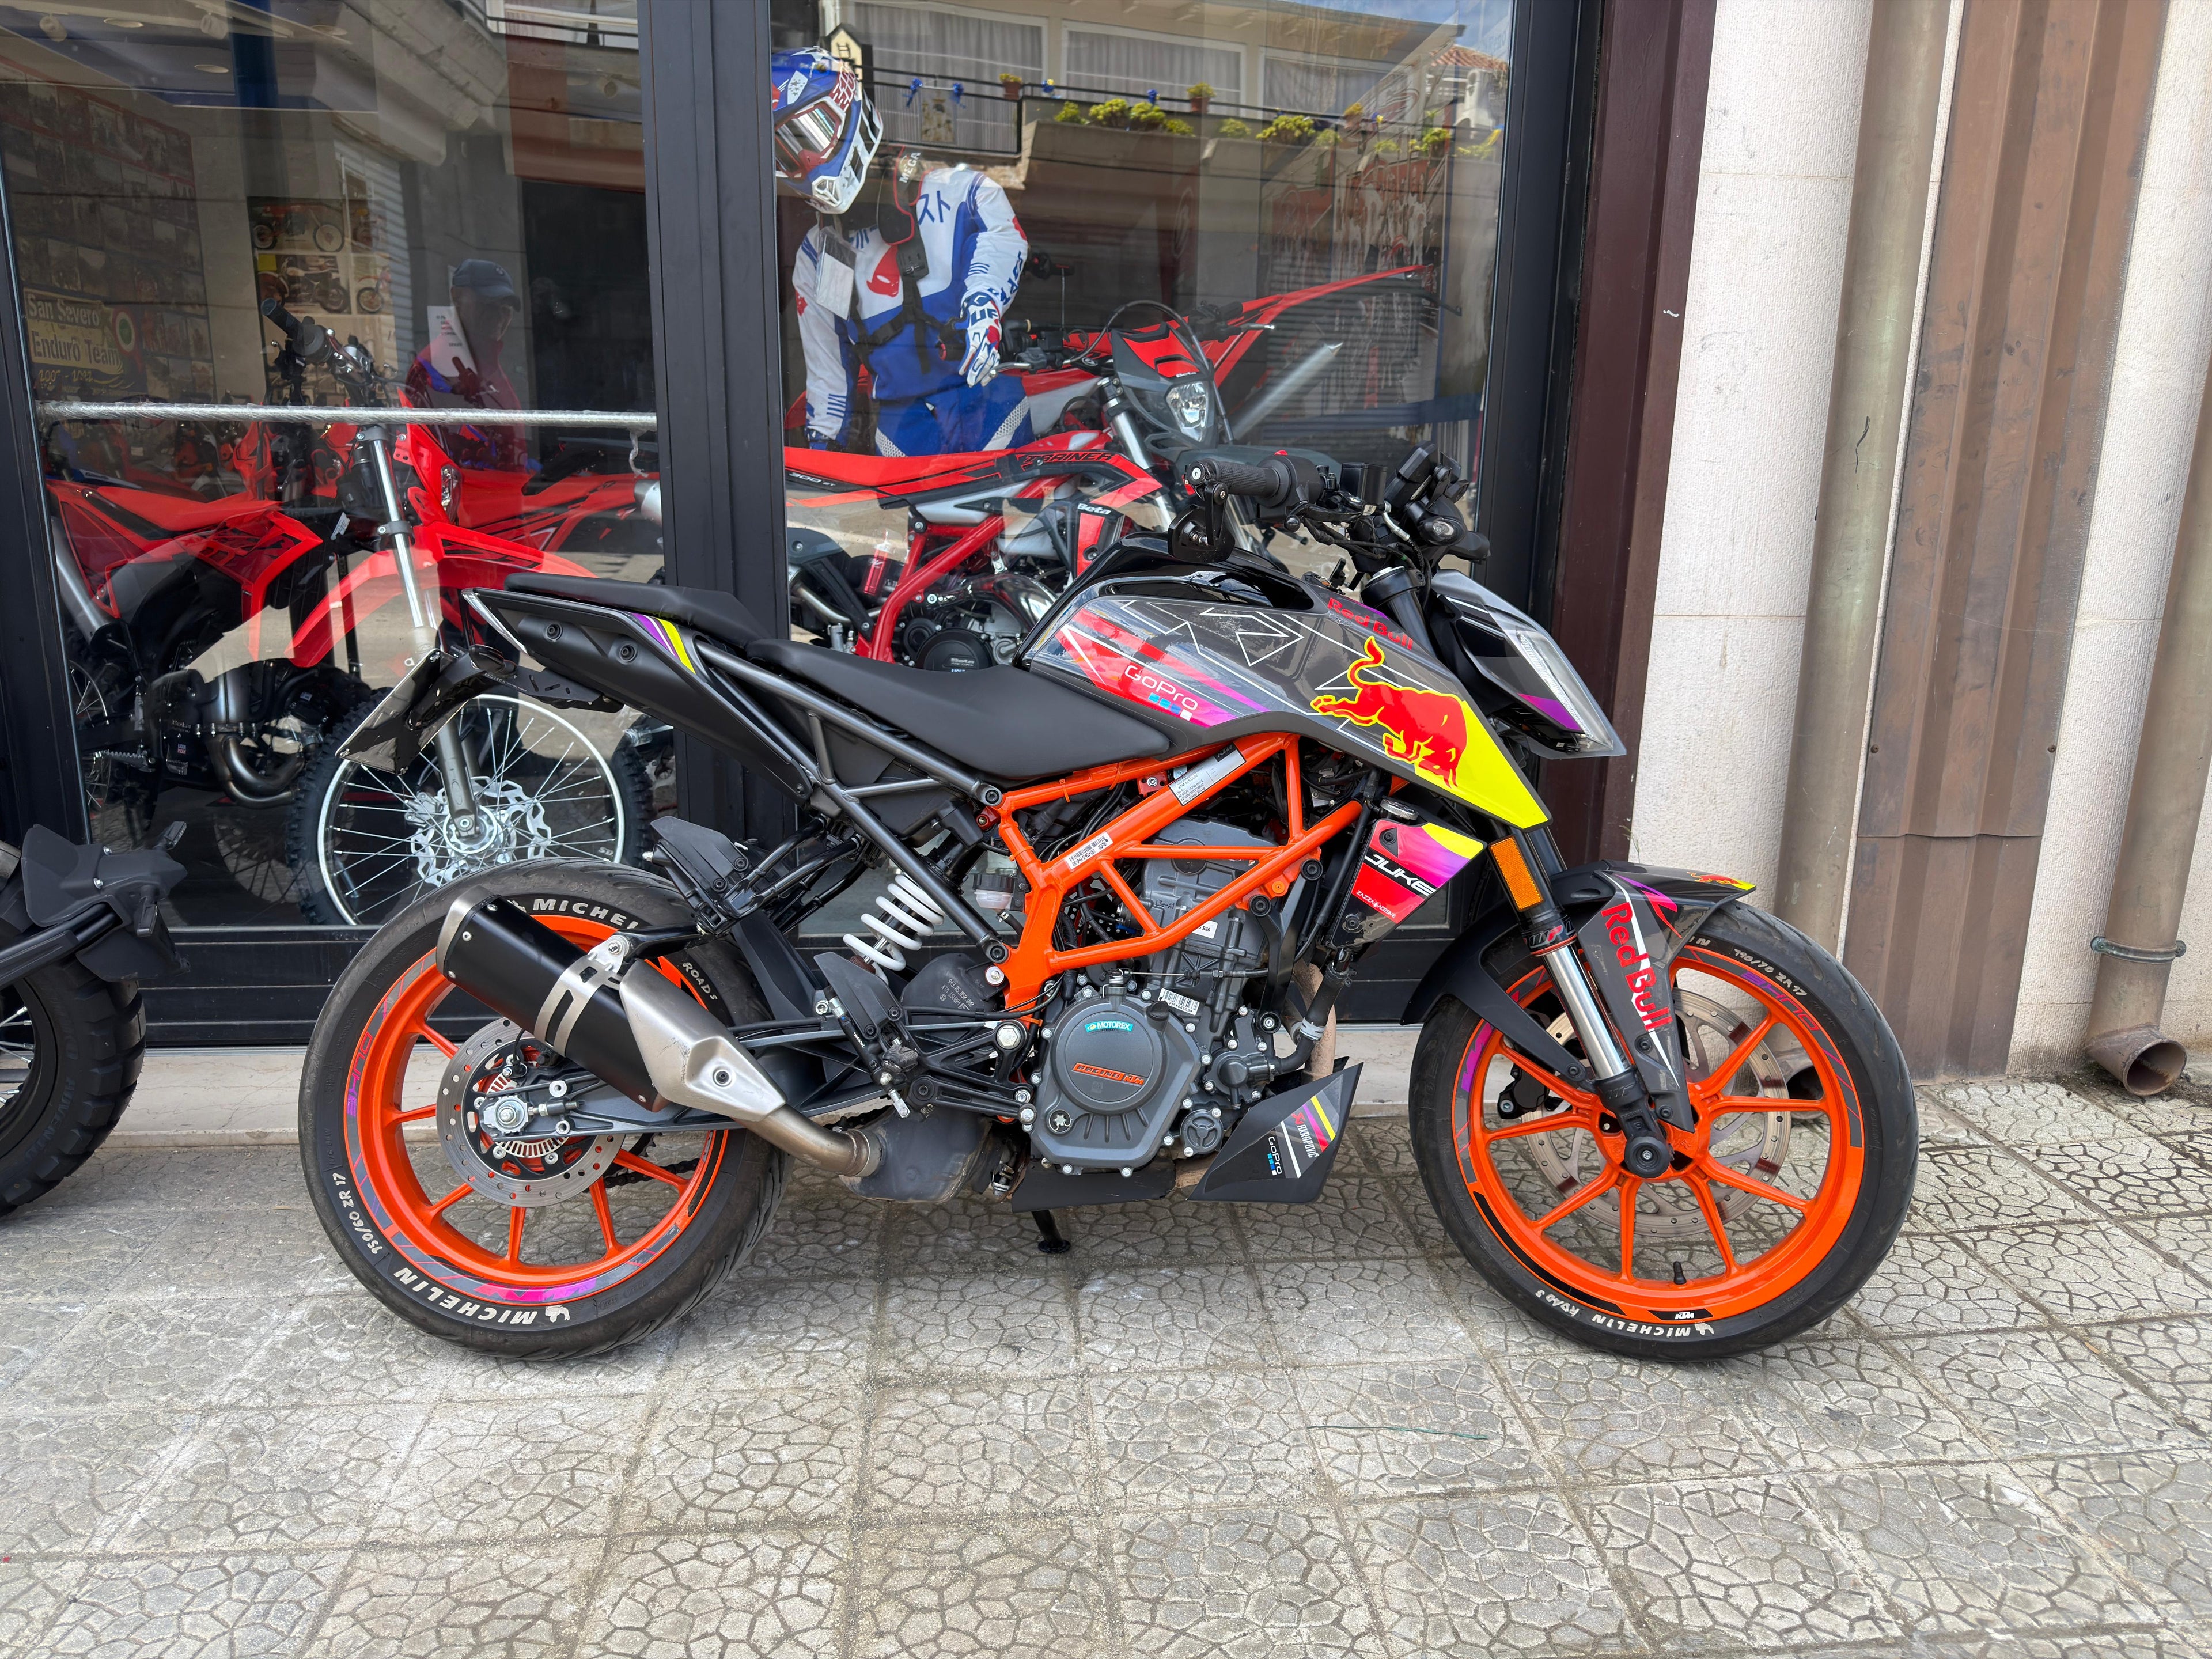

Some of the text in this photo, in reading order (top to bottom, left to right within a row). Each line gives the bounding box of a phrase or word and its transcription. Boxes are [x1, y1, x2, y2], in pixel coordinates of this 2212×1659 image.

[899, 152, 921, 183] MEGA
[28, 294, 100, 326] San Severo
[32, 330, 119, 366] Enduro Team
[789, 472, 822, 483] 300
[1078, 503, 1111, 515] Beta
[1328, 597, 1414, 650] Red Bull
[484, 672, 506, 684] EVOTECH
[1124, 665, 1199, 711] GoPro
[1364, 854, 1437, 896] DUKE
[683, 961, 711, 994] ROAD
[1601, 902, 1673, 1031] Red Bull
[1097, 1021, 1130, 1030] MOTOREX
[1077, 1065, 1145, 1086] RACING KTM
[1268, 1136, 1282, 1175] GoPro
[332, 1173, 383, 1254] 150/60 ZR 17
[393, 1267, 538, 1324] MICHELIN
[1546, 1293, 1580, 1317] ROAD
[1591, 1313, 1691, 1338] MICHELIN
[1675, 1311, 1695, 1320] KTM
